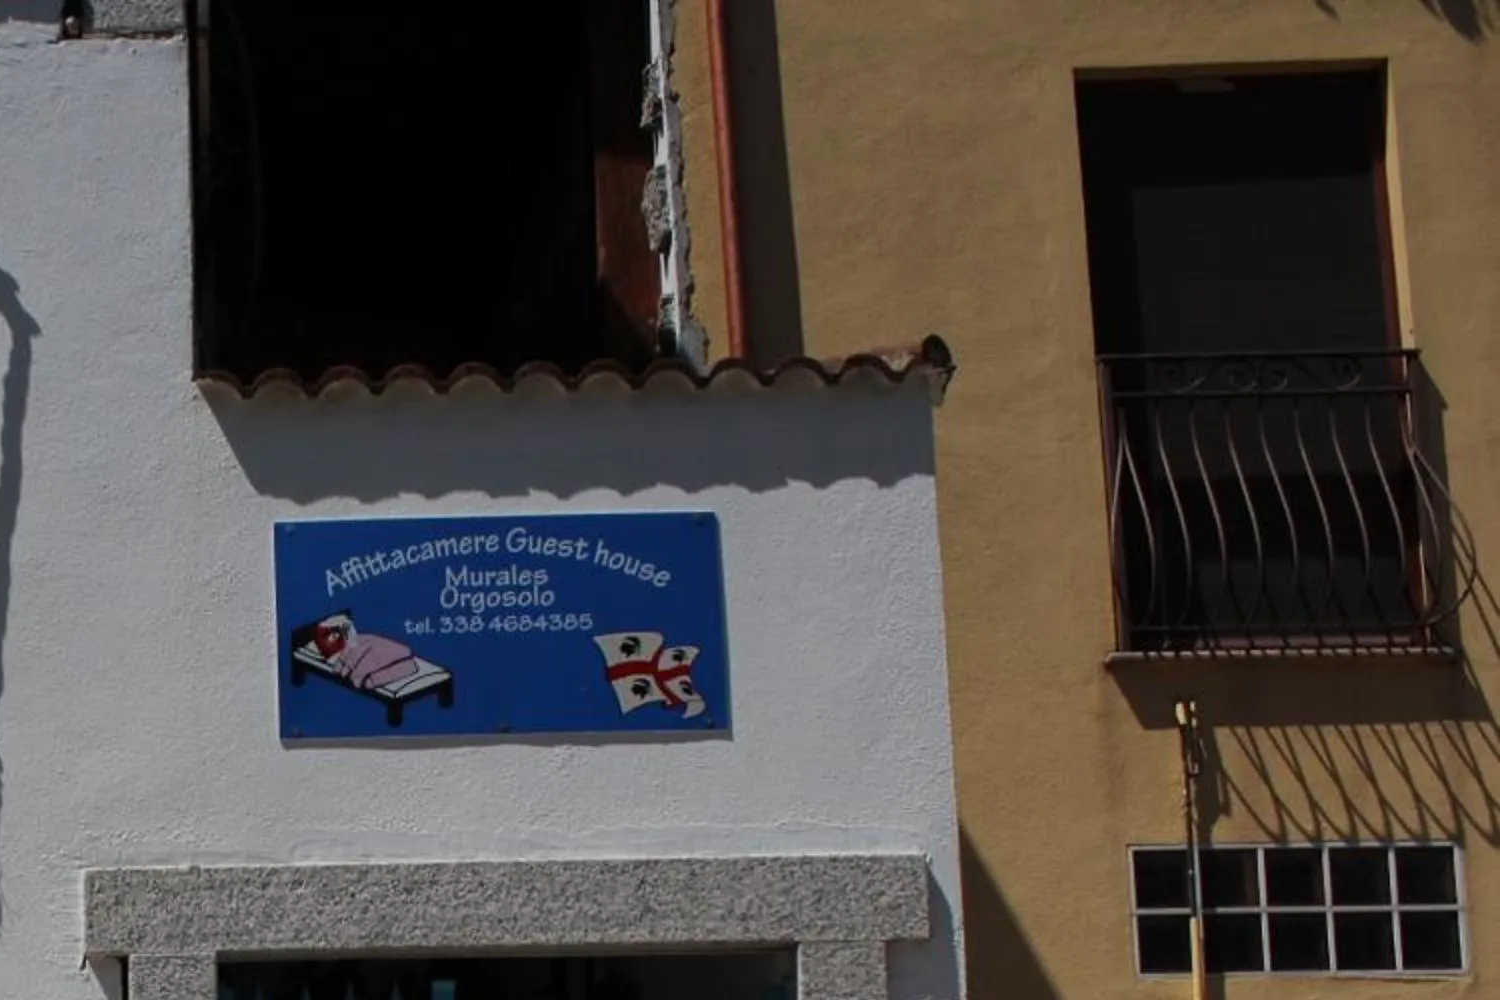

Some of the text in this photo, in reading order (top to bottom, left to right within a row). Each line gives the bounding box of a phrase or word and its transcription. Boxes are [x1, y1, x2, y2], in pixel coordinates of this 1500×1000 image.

[325, 526, 672, 596] Affittacamere Guest house
[445, 564, 549, 588] Murales
[440, 586, 555, 613] Orgosolo
[404, 613, 593, 635] tel. 338 4684385
